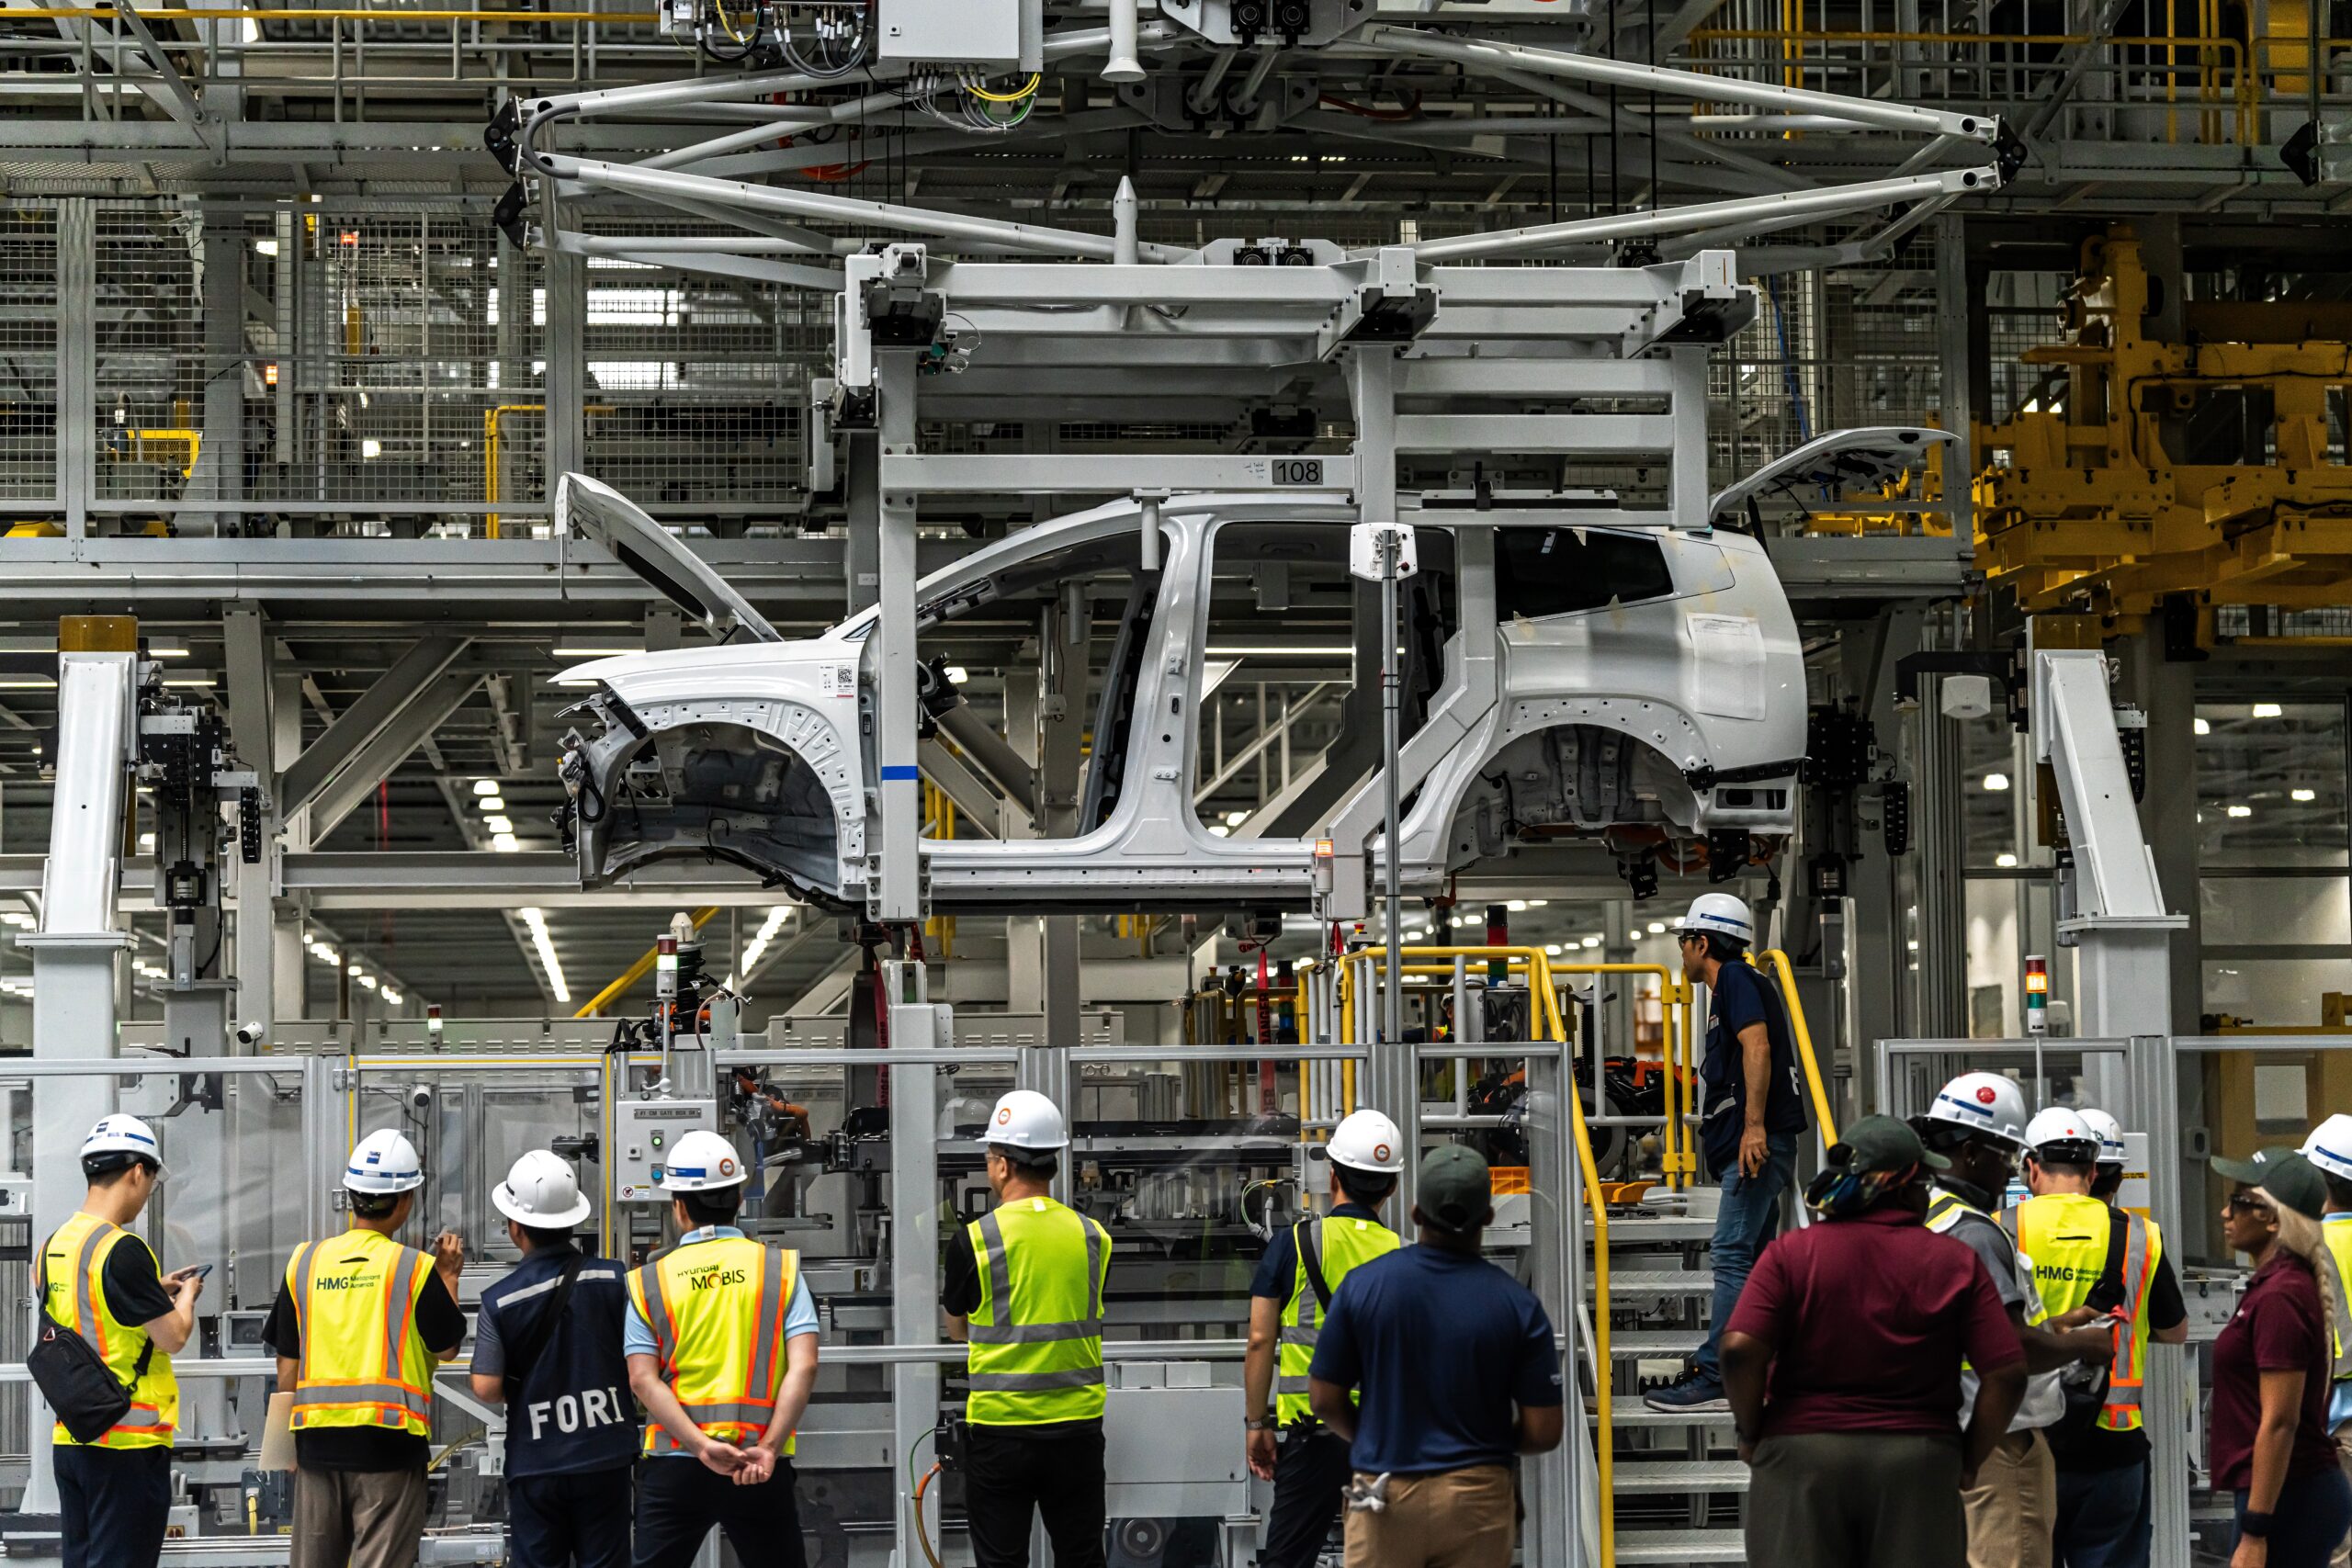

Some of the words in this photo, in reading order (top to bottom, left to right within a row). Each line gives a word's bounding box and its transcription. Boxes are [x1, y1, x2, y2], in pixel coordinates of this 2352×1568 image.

[1278, 462, 1319, 482] 108
[677, 1264, 719, 1278] HYUNDAI
[691, 1269, 745, 1291] MOBIS
[2036, 1265, 2074, 1281] HMG
[316, 1277, 349, 1290] HMG
[527, 1386, 625, 1440] FORI
